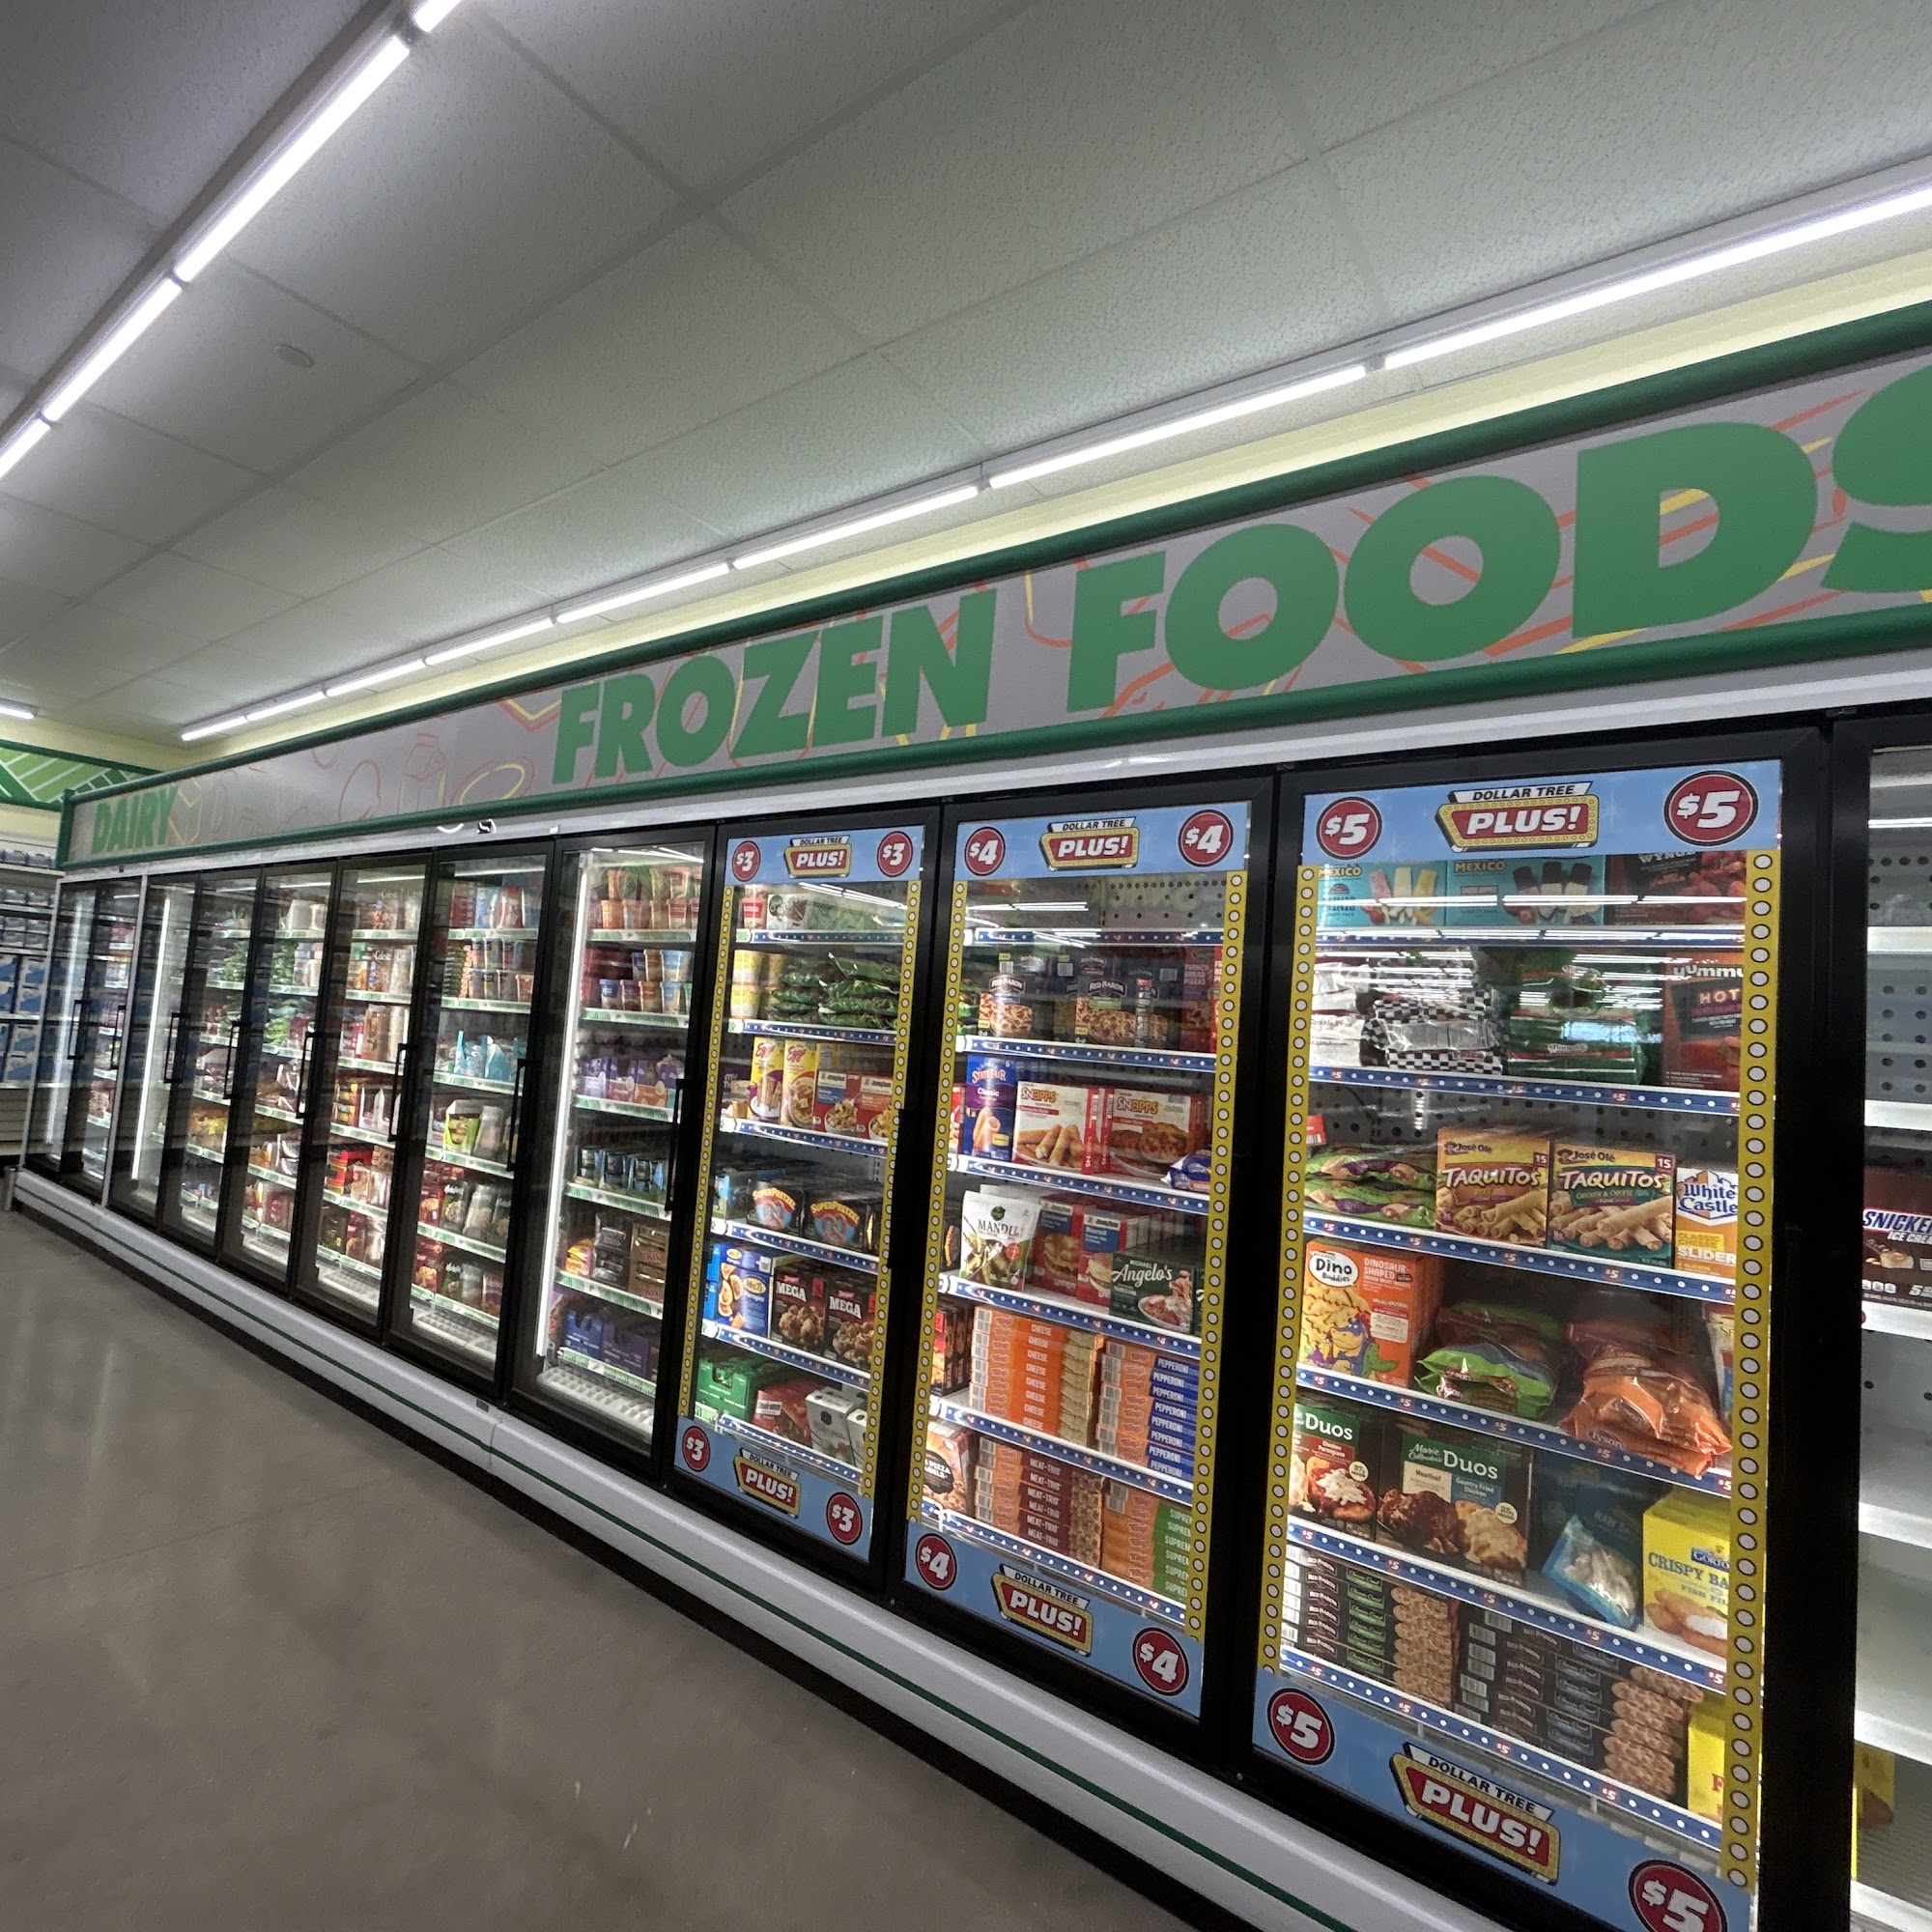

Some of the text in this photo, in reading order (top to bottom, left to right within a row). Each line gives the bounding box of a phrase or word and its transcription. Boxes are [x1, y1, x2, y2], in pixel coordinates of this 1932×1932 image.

[552, 588, 997, 784] FROZEN
[1472, 784, 1575, 800] DOLLAR TREE
[1676, 789, 1741, 827] $5
[91, 784, 178, 854] DAIRY
[1063, 819, 1125, 831] DOLLAR TREE
[1465, 806, 1581, 836] PLUS!
[1324, 812, 1371, 845] $5
[1058, 837, 1128, 858] PLUS!
[1184, 825, 1224, 854] $4
[796, 851, 844, 867] PLUS!
[882, 843, 905, 866] $3
[969, 839, 997, 866] $4
[736, 851, 754, 871] $3
[1455, 860, 1506, 873] MEXICO
[1318, 866, 1362, 879] MEXICO
[1090, 981, 1123, 992] RED BARON
[1699, 988, 1741, 1005] HOT
[1459, 1142, 1492, 1154] José Olé
[1535, 1154, 1547, 1163] 15
[1575, 1151, 1615, 1163] José Olé
[1658, 1158, 1671, 1169] 15
[1443, 1167, 1540, 1188] TAQUITOS
[1559, 1170, 1665, 1190] TAQUITOS
[1685, 1182, 1735, 1198] White
[1679, 1198, 1737, 1213] Castle
[1888, 1231, 1906, 1241] ICE
[1505, 1253, 1517, 1262] $5
[1316, 1259, 1352, 1275] Dino
[1364, 1258, 1410, 1274] DINOSAUR-
[1364, 1266, 1395, 1280] SHAPED
[1605, 1269, 1619, 1279] $5
[1111, 1264, 1173, 1288] Angelo's
[1321, 1272, 1350, 1283] Buddies
[777, 1281, 807, 1302] MEGA
[829, 1295, 862, 1319] MEGA
[1032, 1323, 1051, 1336] CHEESE
[1028, 1336, 1049, 1349] CHEESE
[1028, 1350, 1047, 1362] CHEESE
[1026, 1364, 1046, 1376] CHEESE
[1157, 1358, 1189, 1374] PEPPERONI
[1026, 1378, 1046, 1390] CHEESE
[1153, 1372, 1184, 1387] PEPPERONI
[1315, 1377, 1325, 1385] $5
[1026, 1390, 1045, 1403] CHEESE
[1153, 1387, 1184, 1403] PEPPERONI
[1401, 1399, 1411, 1407] $5
[1024, 1404, 1045, 1416] CHEESE
[1155, 1403, 1186, 1418] PEPPERONI
[1024, 1417, 1043, 1430] CHEESE
[1151, 1416, 1182, 1432] PEPPERONI
[1304, 1413, 1352, 1441] Duos
[1151, 1431, 1182, 1447] PEPPERONI
[1592, 1431, 1623, 1448] Tyson
[686, 1436, 704, 1461] $3
[1150, 1445, 1180, 1463] PEPPERONI
[1408, 1444, 1439, 1457] Marie
[1598, 1449, 1611, 1459] $5
[750, 1453, 792, 1478] DOLLAR TREE
[1151, 1461, 1182, 1477] PEPPERONI
[1443, 1450, 1498, 1480] Duos
[746, 1470, 794, 1503] PLUS!
[831, 1503, 854, 1532] $3
[1302, 1530, 1314, 1540] $5
[920, 1548, 951, 1580] $4
[1389, 1560, 1400, 1570] $5
[1648, 1551, 1704, 1580] CRISPY
[1014, 1573, 1079, 1605] DOLLAR TREE
[1318, 1576, 1335, 1590] BARON
[1320, 1593, 1337, 1607] BARON
[1485, 1593, 1495, 1604] $5
[1009, 1589, 1082, 1636] PLUS!
[1320, 1607, 1337, 1621] BARON
[1586, 1629, 1601, 1640] $5
[1140, 1643, 1179, 1684] $4
[1311, 1666, 1322, 1676] $5
[1708, 1671, 1723, 1685] $5
[1399, 1702, 1410, 1712] $5
[1276, 1704, 1322, 1748] $5
[1497, 1743, 1511, 1754] $5
[1428, 1756, 1536, 1813] DOLLAR TREE
[1602, 1788, 1617, 1801] $5
[1422, 1779, 1542, 1855] PLUS!
[1642, 1880, 1709, 1932] $5
